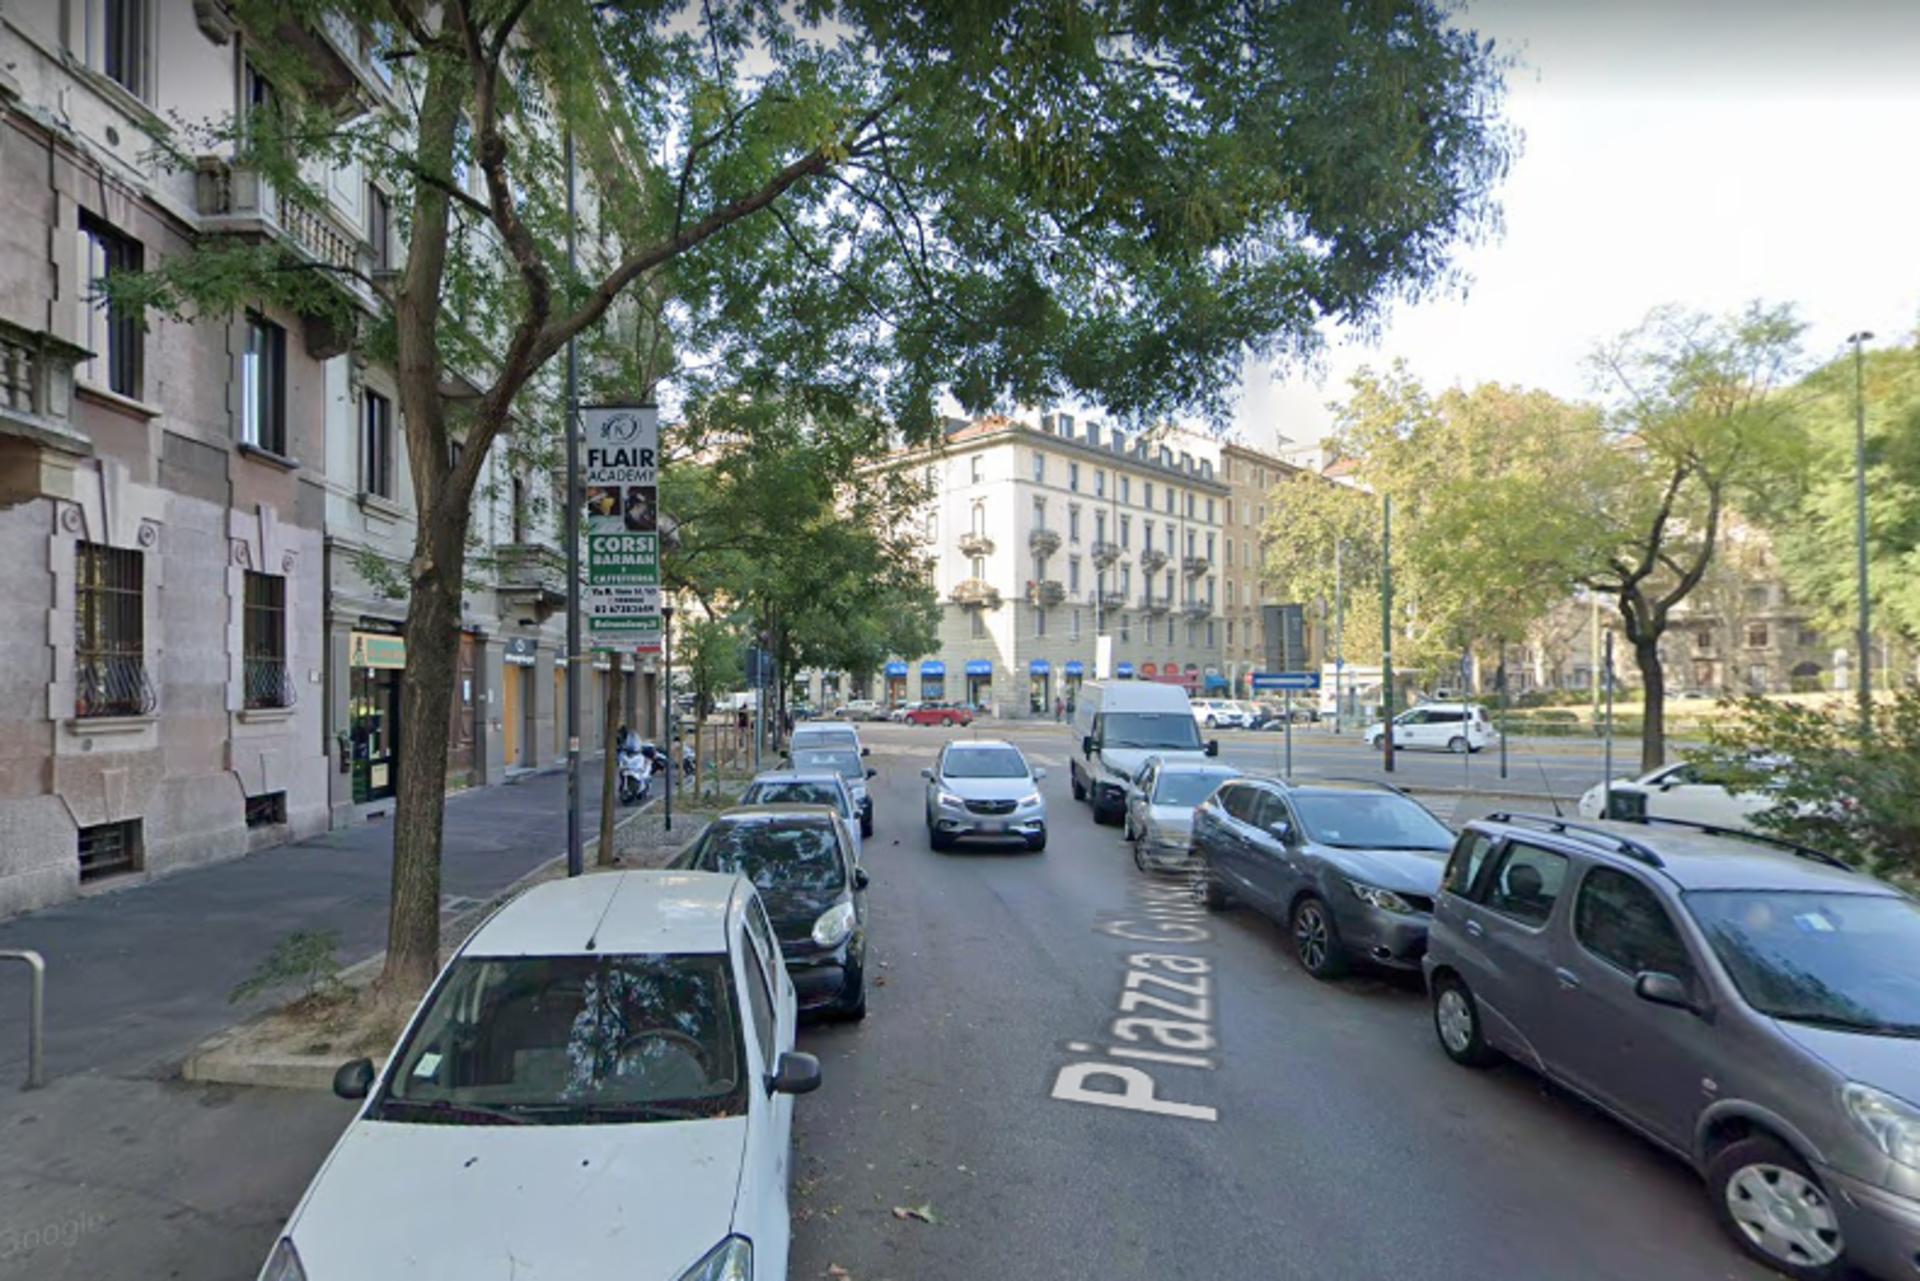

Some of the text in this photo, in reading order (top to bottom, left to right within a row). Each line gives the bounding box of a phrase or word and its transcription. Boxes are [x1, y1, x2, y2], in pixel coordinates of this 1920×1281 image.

[588, 448, 654, 467] FLAIR
[588, 469, 655, 482] ACADEMY
[593, 536, 655, 553] CORSI
[593, 553, 655, 565] BARMAN
